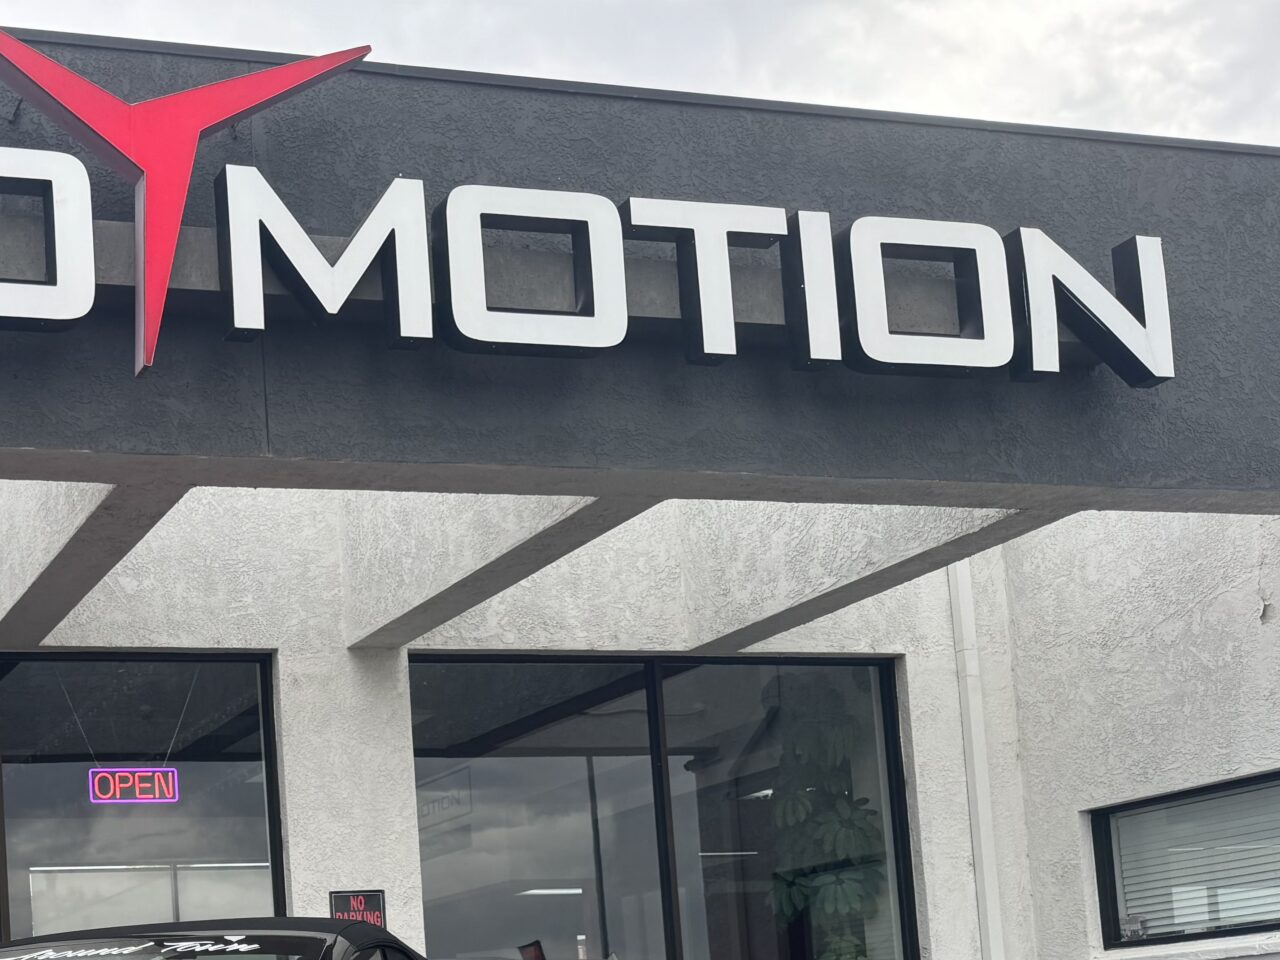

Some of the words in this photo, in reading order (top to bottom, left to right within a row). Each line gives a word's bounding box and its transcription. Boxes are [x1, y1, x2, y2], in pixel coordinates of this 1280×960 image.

[223, 163, 1176, 379] MOTION
[94, 771, 174, 800] OPEN
[349, 895, 365, 911] NO
